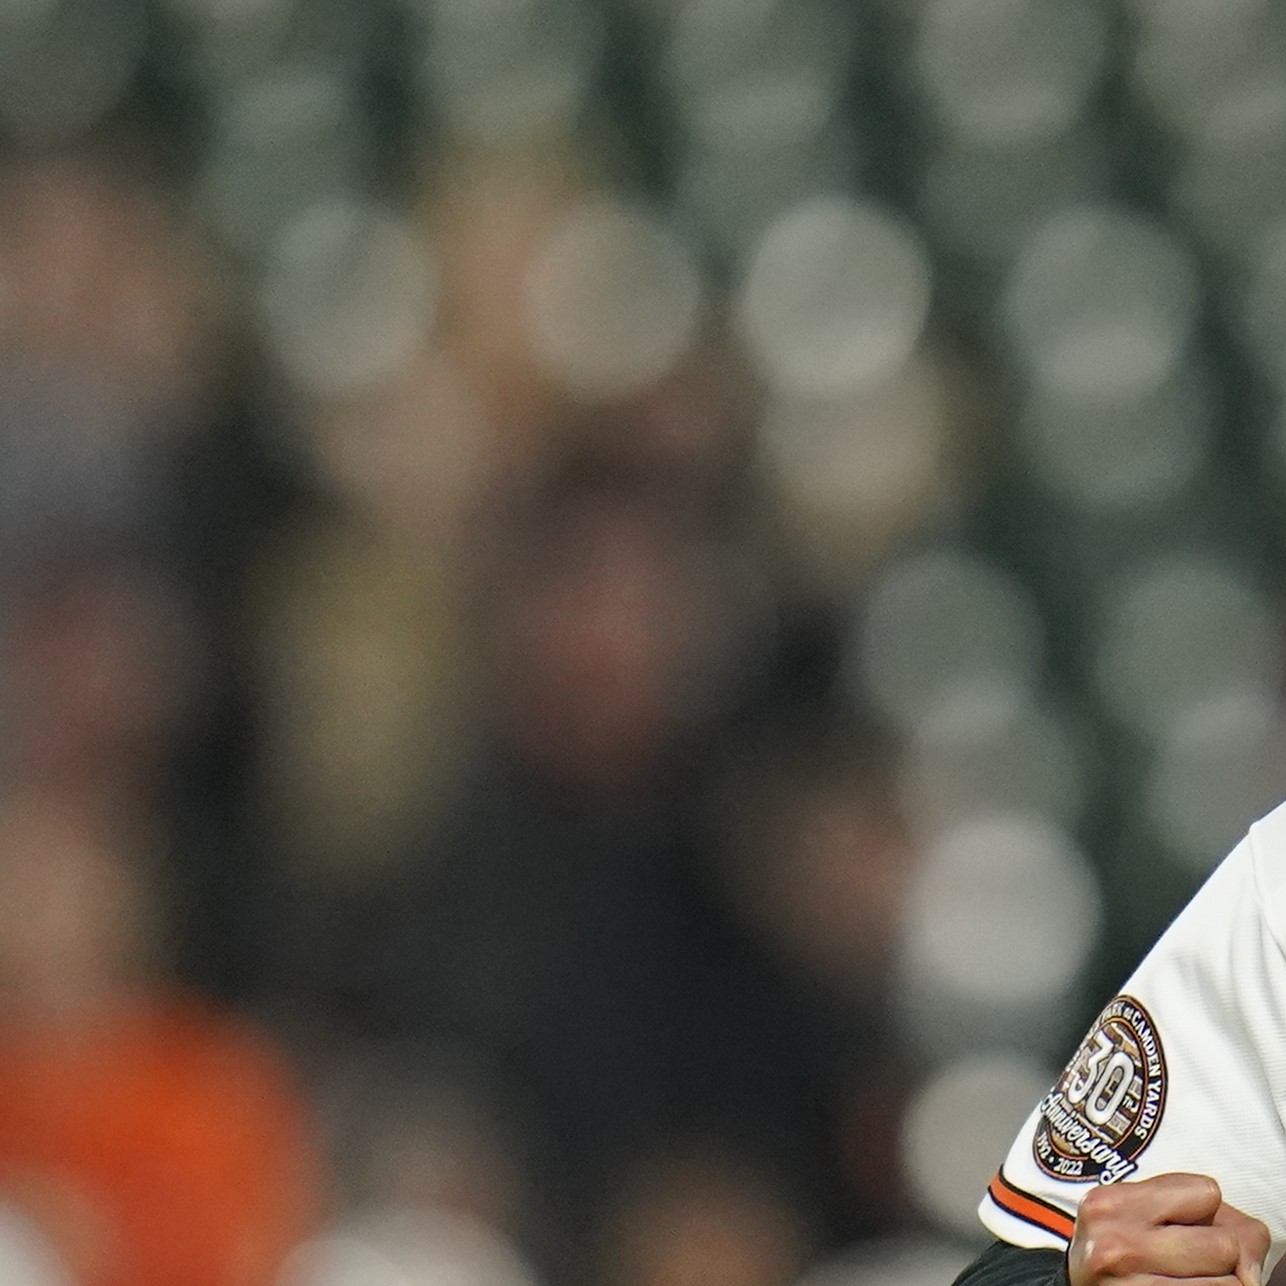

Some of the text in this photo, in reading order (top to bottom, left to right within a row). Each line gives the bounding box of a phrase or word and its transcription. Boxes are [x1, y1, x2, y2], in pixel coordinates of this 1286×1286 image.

[1067, 1029, 1136, 1126] 30
[1132, 1010, 1161, 1078] CAMDEN
[1041, 1092, 1136, 1186] Anniversary
[1135, 1079, 1162, 1140] YARDS
[1053, 1158, 1084, 1176] 2022
